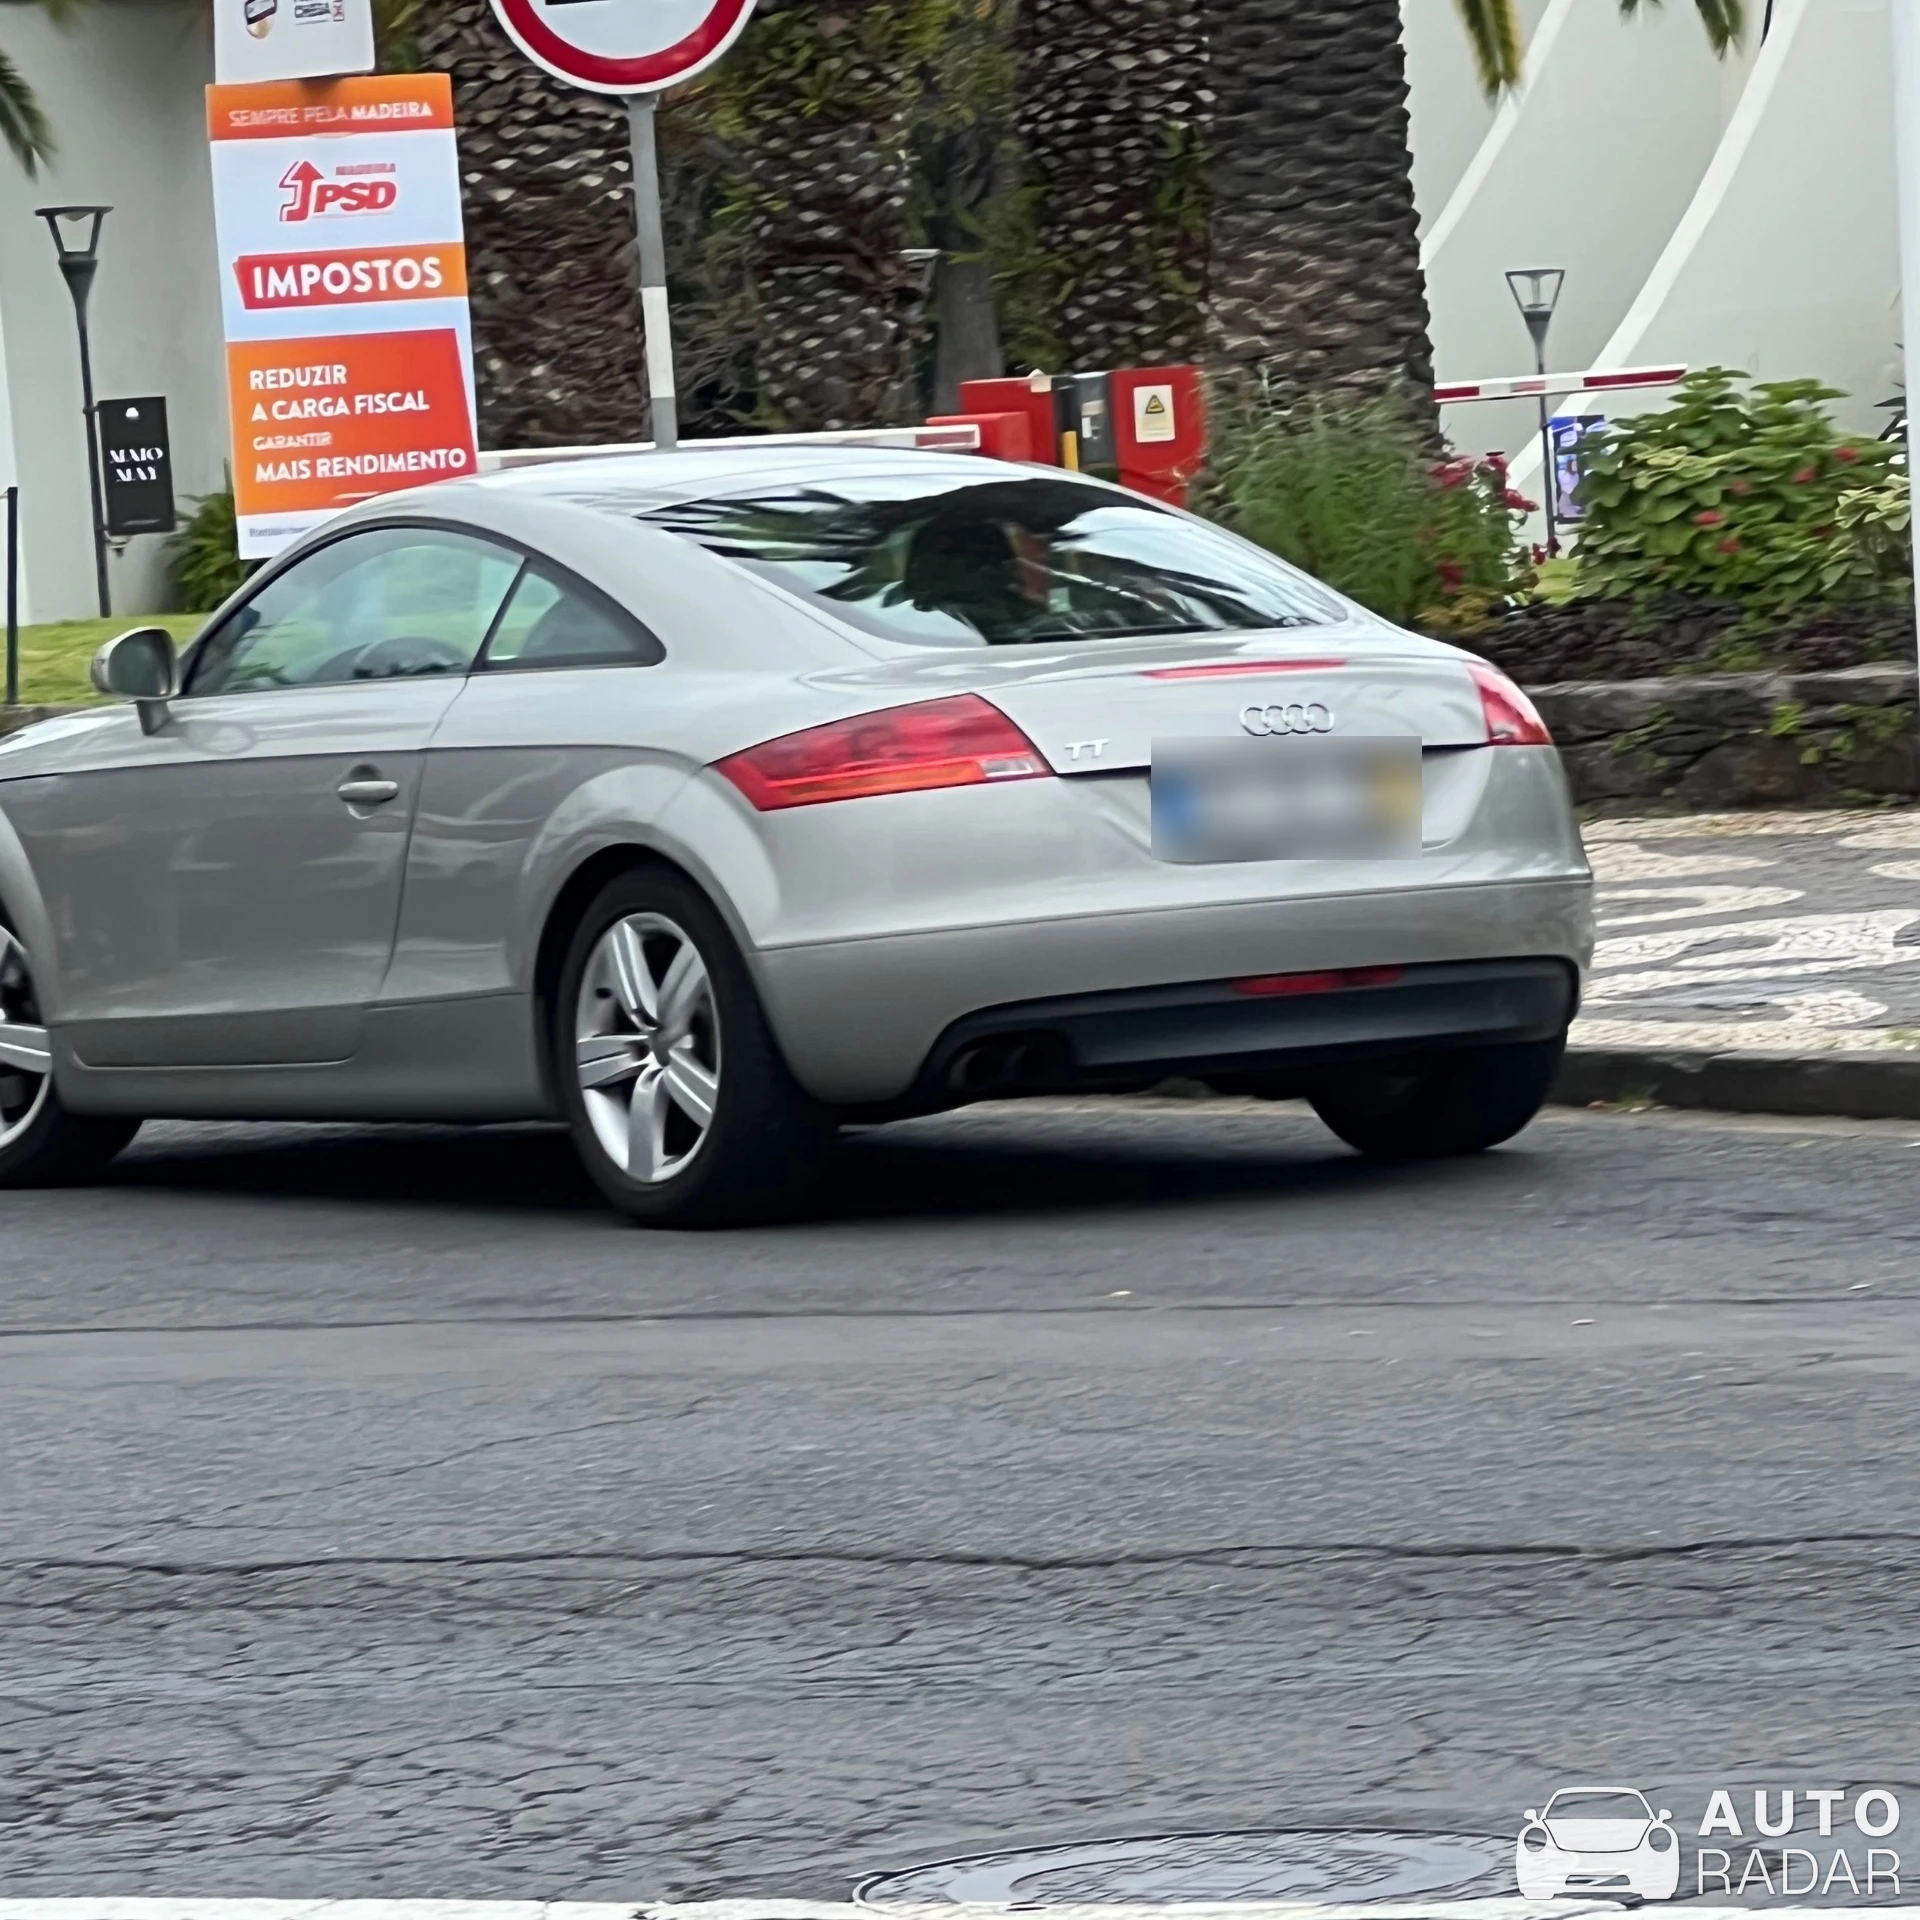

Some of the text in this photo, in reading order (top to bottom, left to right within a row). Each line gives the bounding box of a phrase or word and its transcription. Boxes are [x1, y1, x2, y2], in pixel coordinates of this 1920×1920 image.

[229, 102, 433, 127] SEMPRE PELA MADEIRA
[314, 181, 398, 213] PSD
[253, 257, 443, 299] IMPOSTOS
[249, 364, 347, 390] REDUZIR
[251, 391, 430, 421] A CARGA FISCAL
[256, 448, 467, 482] MAIS RENDIMENTO
[1064, 738, 1110, 761] TT
